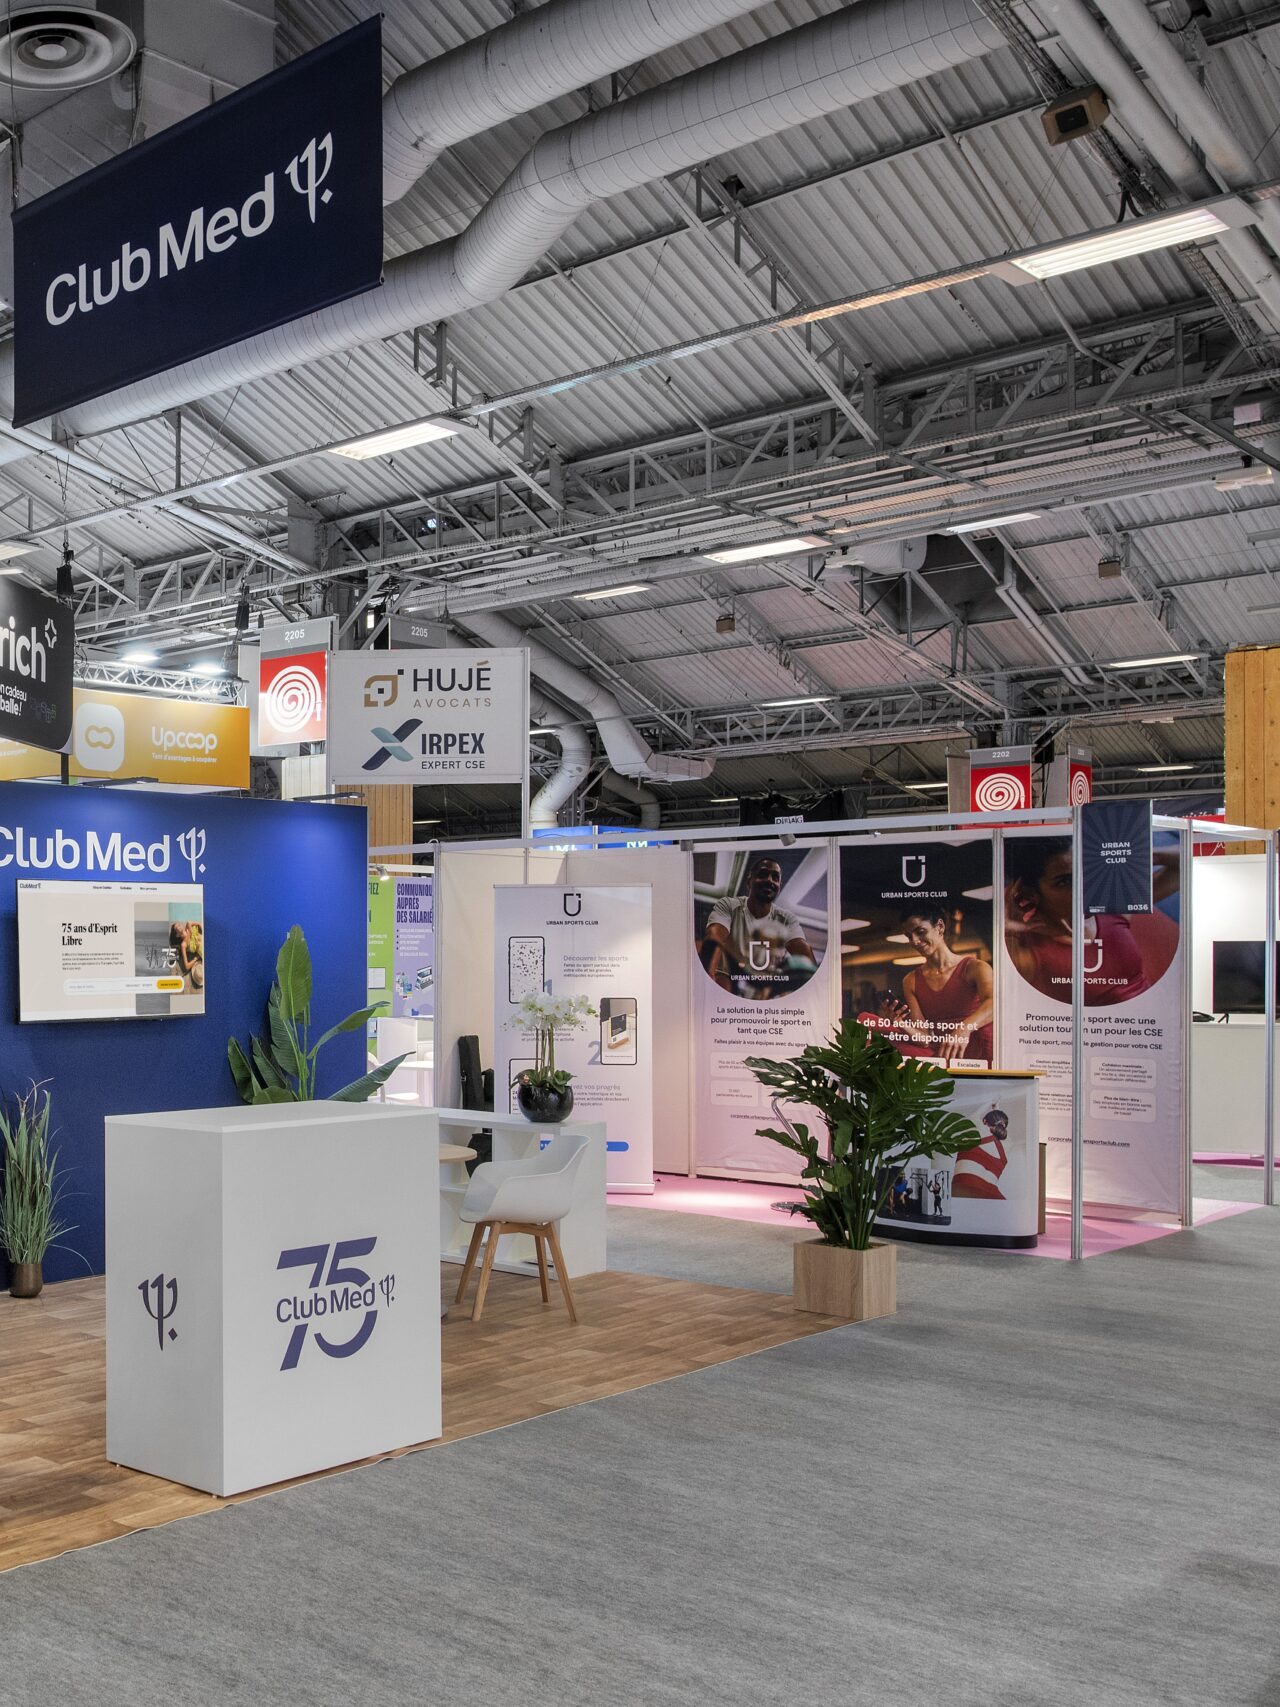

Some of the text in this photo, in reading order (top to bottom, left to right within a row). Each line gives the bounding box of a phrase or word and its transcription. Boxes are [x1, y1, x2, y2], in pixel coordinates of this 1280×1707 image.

[45, 172, 275, 326] Club Med
[284, 628, 305, 642] 2205
[411, 626, 428, 638] 2205
[412, 660, 491, 692] HUJÉ
[6, 685, 27, 702] cadeau
[413, 697, 491, 708] AVOCATS
[422, 732, 485, 755] IRPEX
[992, 750, 1010, 758] 2202
[421, 760, 486, 770] EXPERT CSE
[86, 830, 170, 873] Med
[396, 883, 432, 896] COMMUNIQU
[396, 909, 432, 923] DES SALARIÉ
[62, 923, 72, 933] 75
[74, 925, 87, 933] ans
[62, 936, 82, 946] Libre
[764, 1008, 779, 1016] plus
[781, 1008, 805, 1016] simple
[781, 1018, 800, 1026] sport
[864, 1018, 978, 1031] de 50 activités sport et
[1088, 1016, 1112, 1025] sport
[1019, 1025, 1054, 1033] solution
[1104, 1028, 1126, 1036] pour
[1129, 1028, 1142, 1036] les
[1144, 1028, 1163, 1037] CSE
[912, 1033, 969, 1044] disponibles
[276, 1282, 376, 1323] Club Med
[276, 1236, 378, 1372] 75
